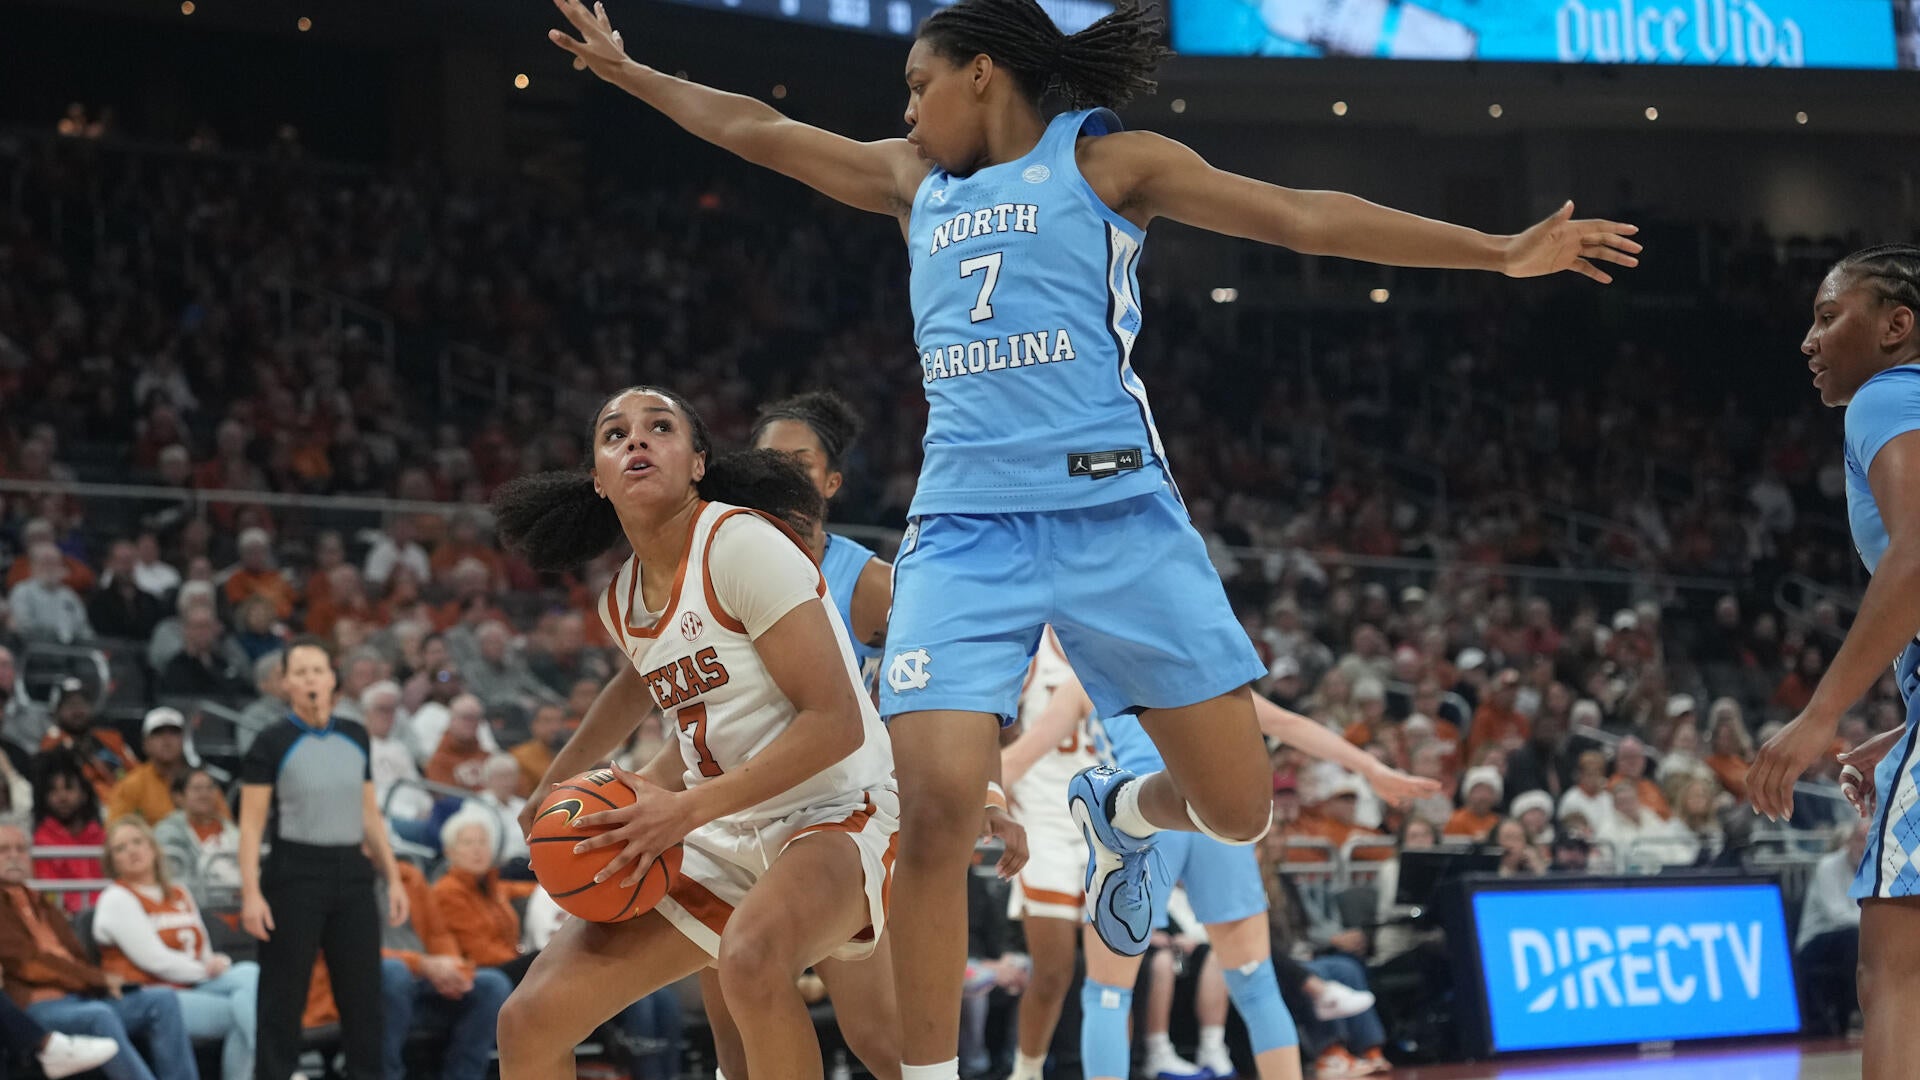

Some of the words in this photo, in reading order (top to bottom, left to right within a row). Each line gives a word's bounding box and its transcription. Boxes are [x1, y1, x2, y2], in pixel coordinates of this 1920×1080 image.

[1556, 0, 1688, 63] Dulce
[930, 203, 1038, 257] NORTH
[959, 251, 1002, 324] 7
[922, 329, 1076, 383] CAROLINA
[677, 701, 725, 778] 7
[1509, 920, 1763, 1014] DIRECTV
